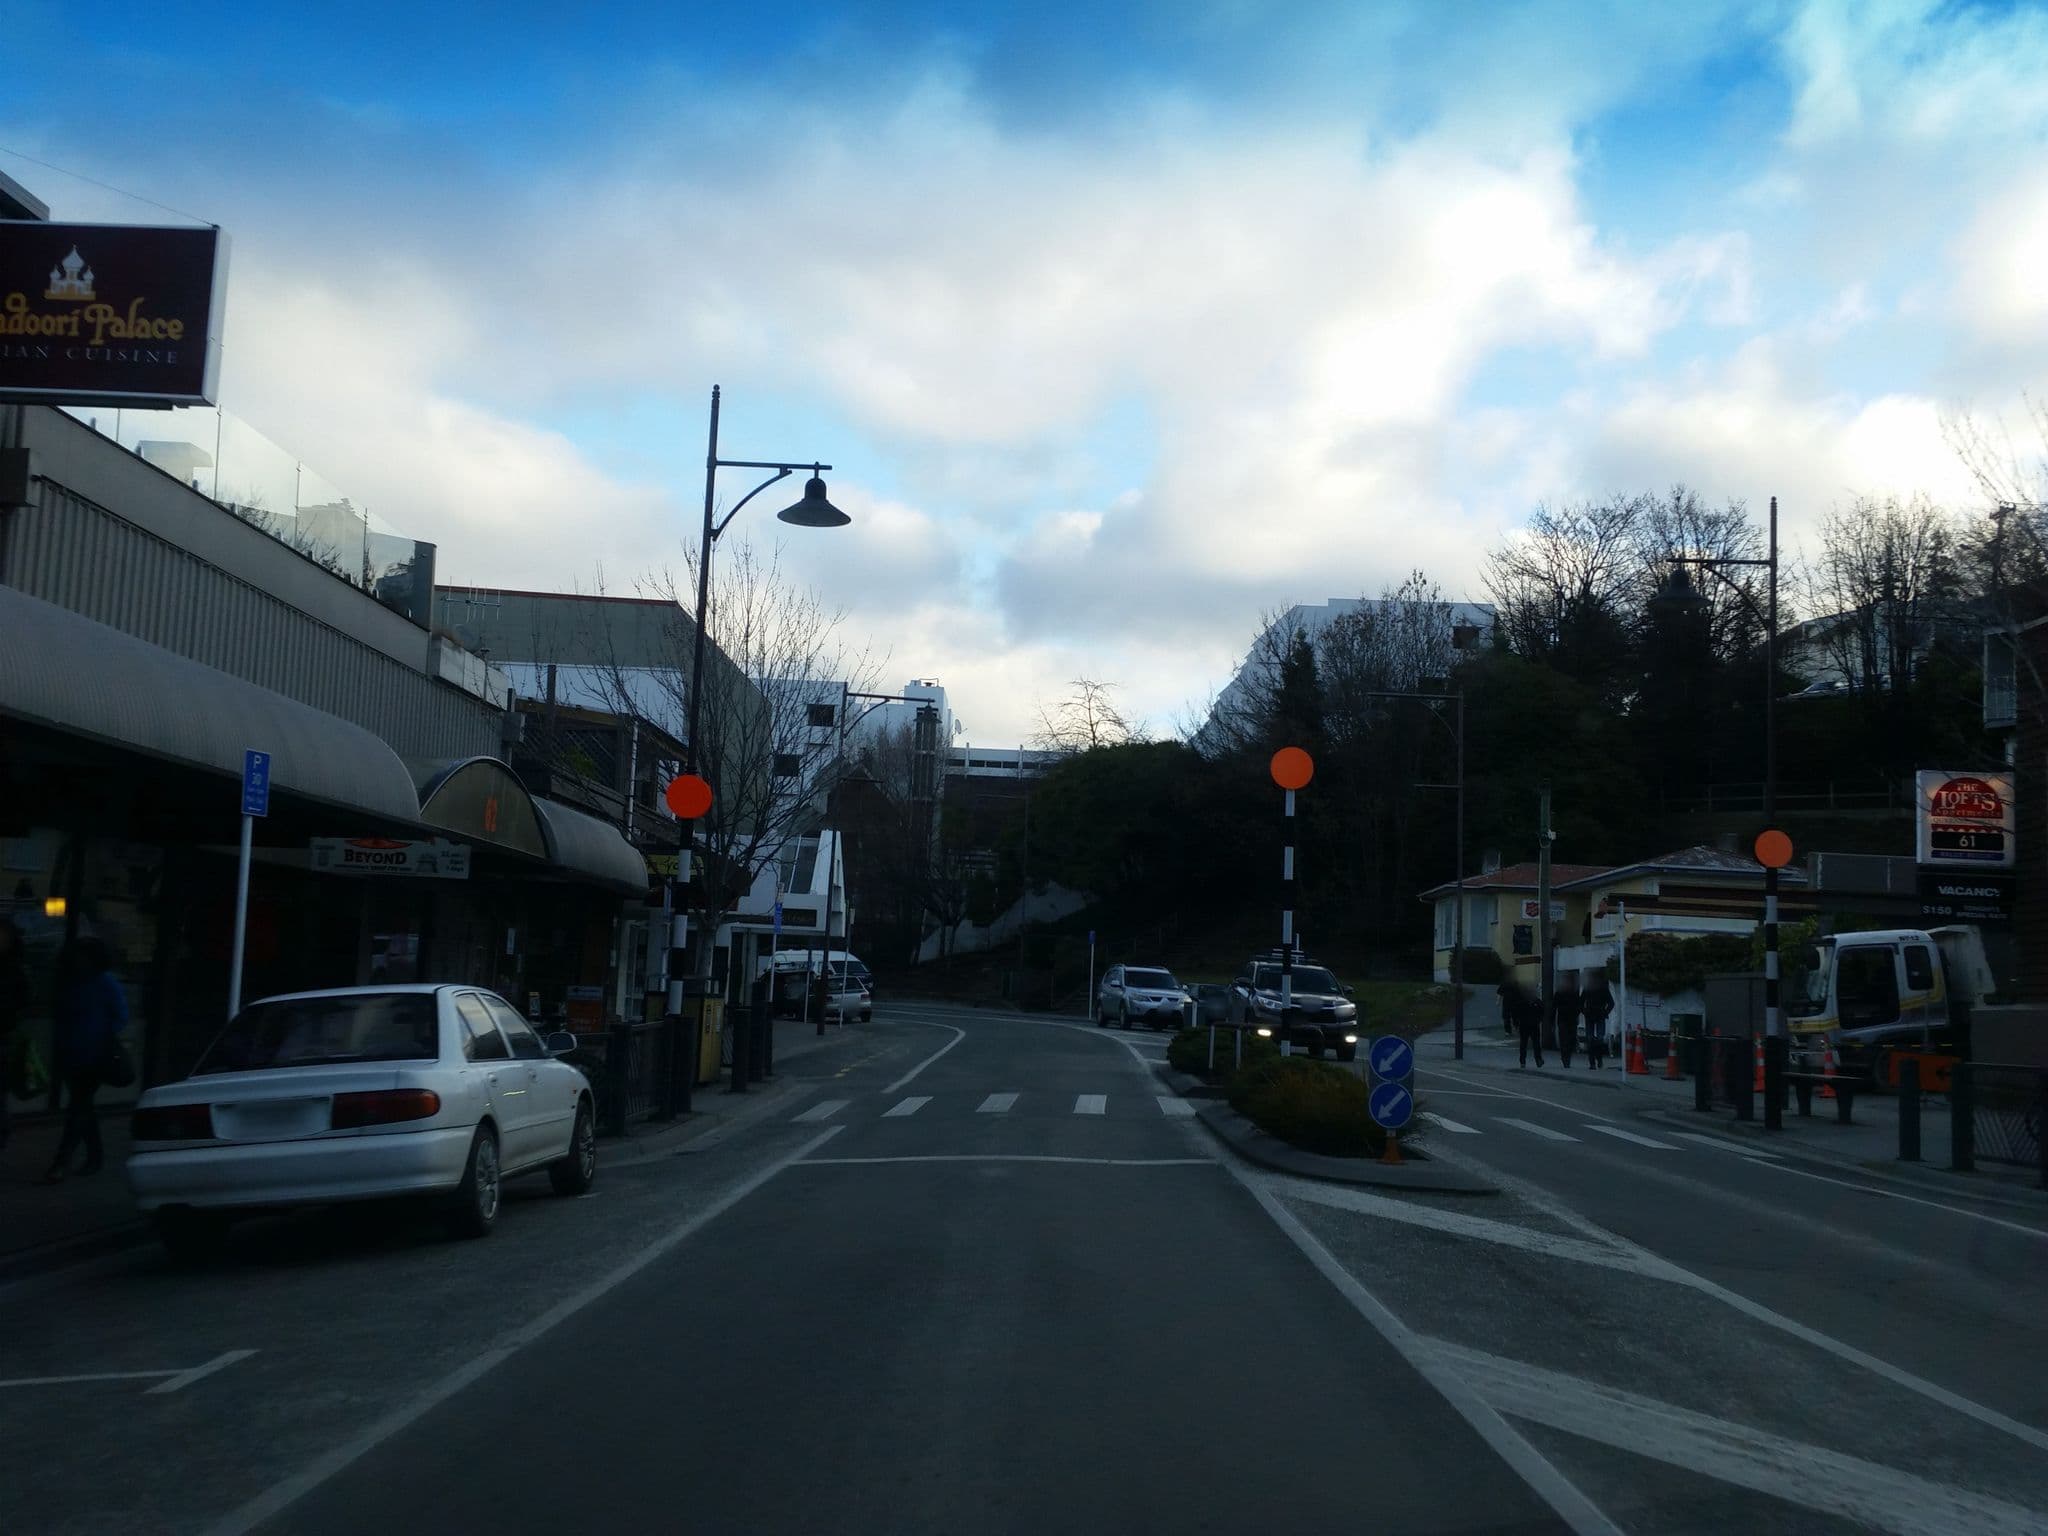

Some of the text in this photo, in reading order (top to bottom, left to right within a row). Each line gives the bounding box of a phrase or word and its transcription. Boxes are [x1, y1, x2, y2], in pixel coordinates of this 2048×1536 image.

[84, 297, 184, 346] Palace
[64, 346, 178, 363] CUISINE
[253, 754, 262, 769] P
[1956, 783, 1979, 792] THE
[1939, 790, 1996, 811] LOFTS
[1959, 835, 1976, 848] 61
[343, 849, 407, 865] BEYOND
